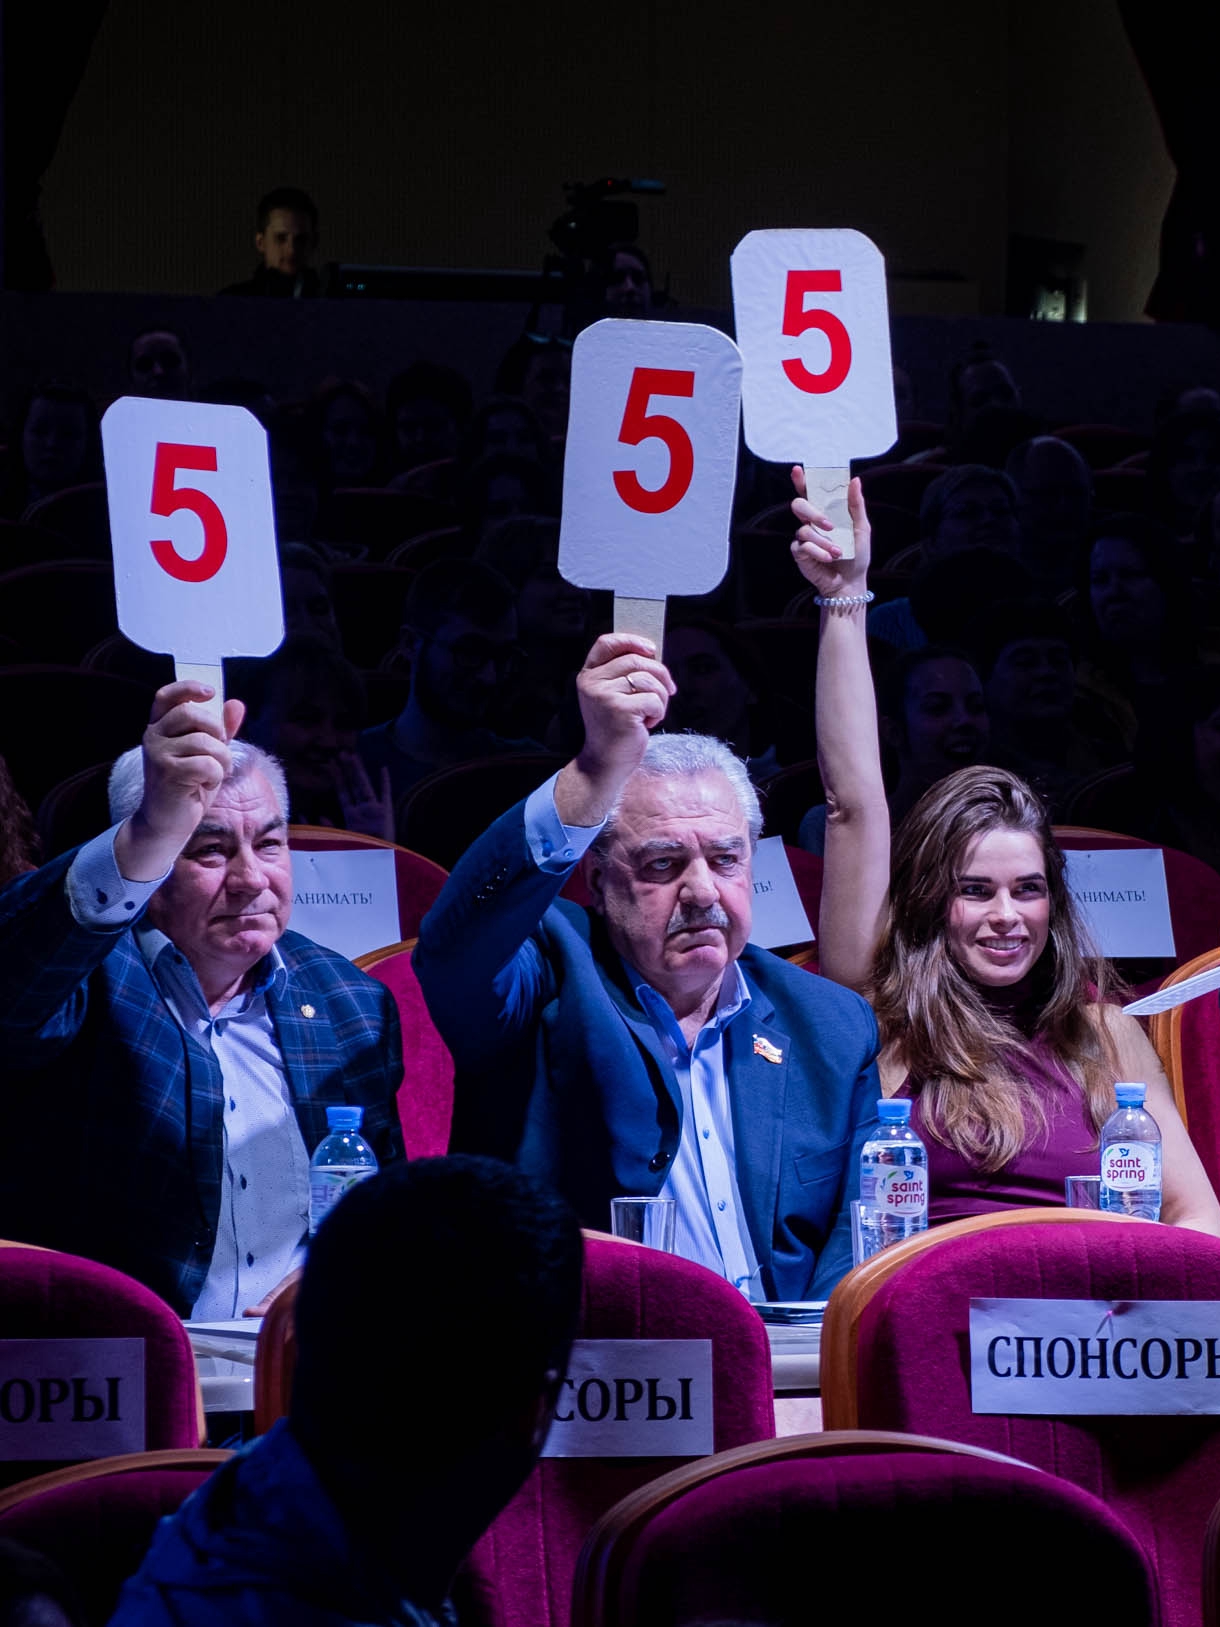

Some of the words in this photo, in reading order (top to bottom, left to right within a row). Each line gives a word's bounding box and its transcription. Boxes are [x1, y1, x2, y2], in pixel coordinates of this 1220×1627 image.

[781, 270, 852, 394] 5
[612, 367, 695, 514] 5
[150, 442, 228, 583] 5
[292, 892, 374, 905] АНИМАТЬ!
[1109, 1157, 1141, 1168] saint
[1106, 1169, 1145, 1182] spring
[891, 1181, 923, 1192] saint
[887, 1193, 925, 1207] spring
